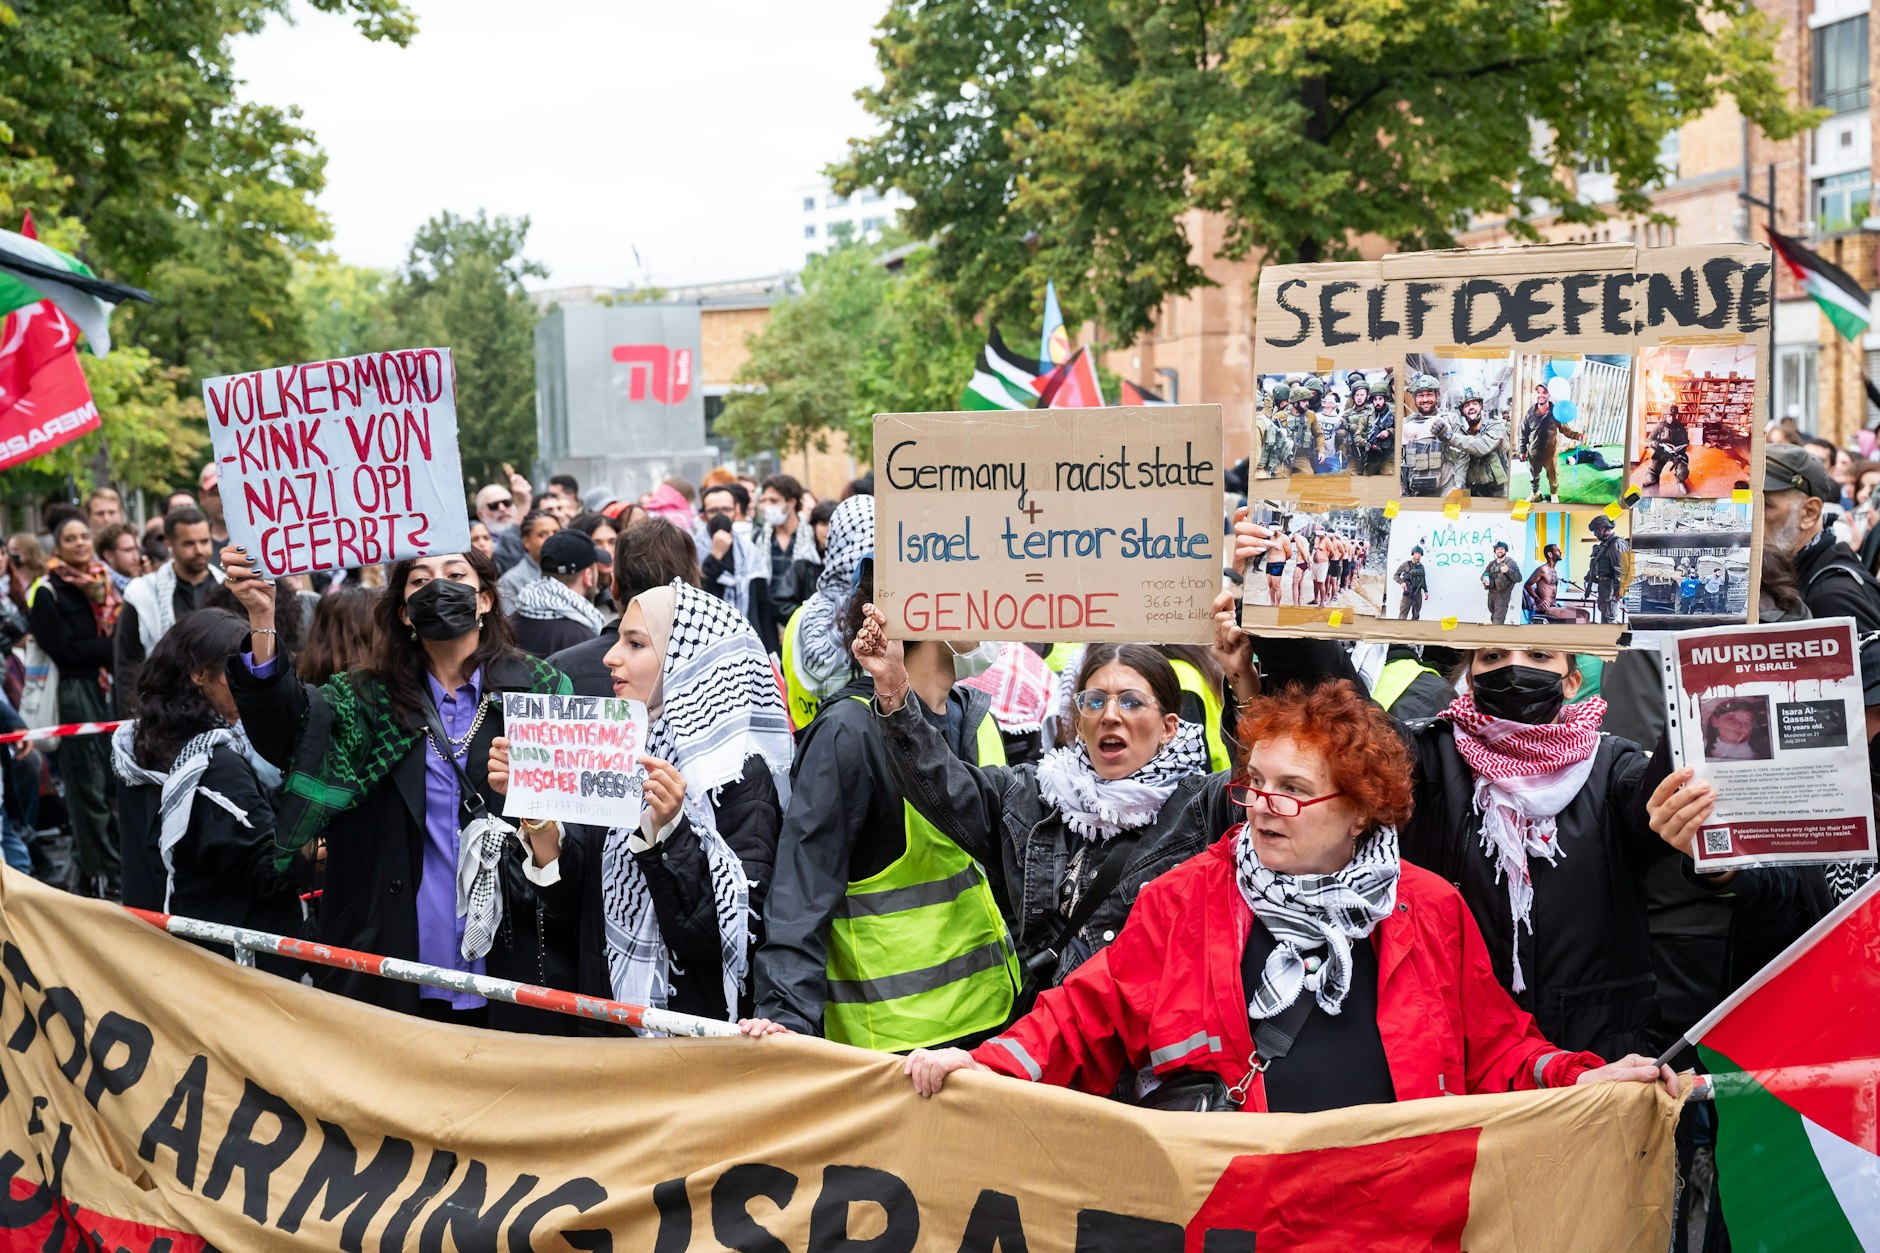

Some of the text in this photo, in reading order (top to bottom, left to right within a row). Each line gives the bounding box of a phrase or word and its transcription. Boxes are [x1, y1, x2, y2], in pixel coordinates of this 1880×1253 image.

[208, 349, 443, 427] VÖLKERMORD
[345, 407, 431, 463] VON
[886, 440, 1028, 510] Germany
[243, 464, 412, 526] NAZI OPI
[899, 515, 980, 562] Israel
[1432, 527, 1493, 547] NAKBA
[1436, 552, 1485, 567] 2023
[1141, 576, 1214, 590] more than
[878, 589, 1119, 631] for GENOCIDE
[1146, 610, 1185, 623] people
[1691, 638, 1840, 665] MURDERED
[1736, 661, 1797, 673] BY ISRAEL
[504, 693, 545, 720] KEIN
[548, 693, 600, 720] PLATZ
[1782, 708, 1803, 716] Isara
[507, 721, 637, 750] ANTISEMITISMUS
[1792, 724, 1811, 732] years
[508, 745, 551, 763] UND
[1733, 827, 1769, 835] Palestinians
[1739, 832, 1775, 840] Palestinians
[0, 941, 154, 1113] TOP
[138, 1055, 613, 1253] ARMING
